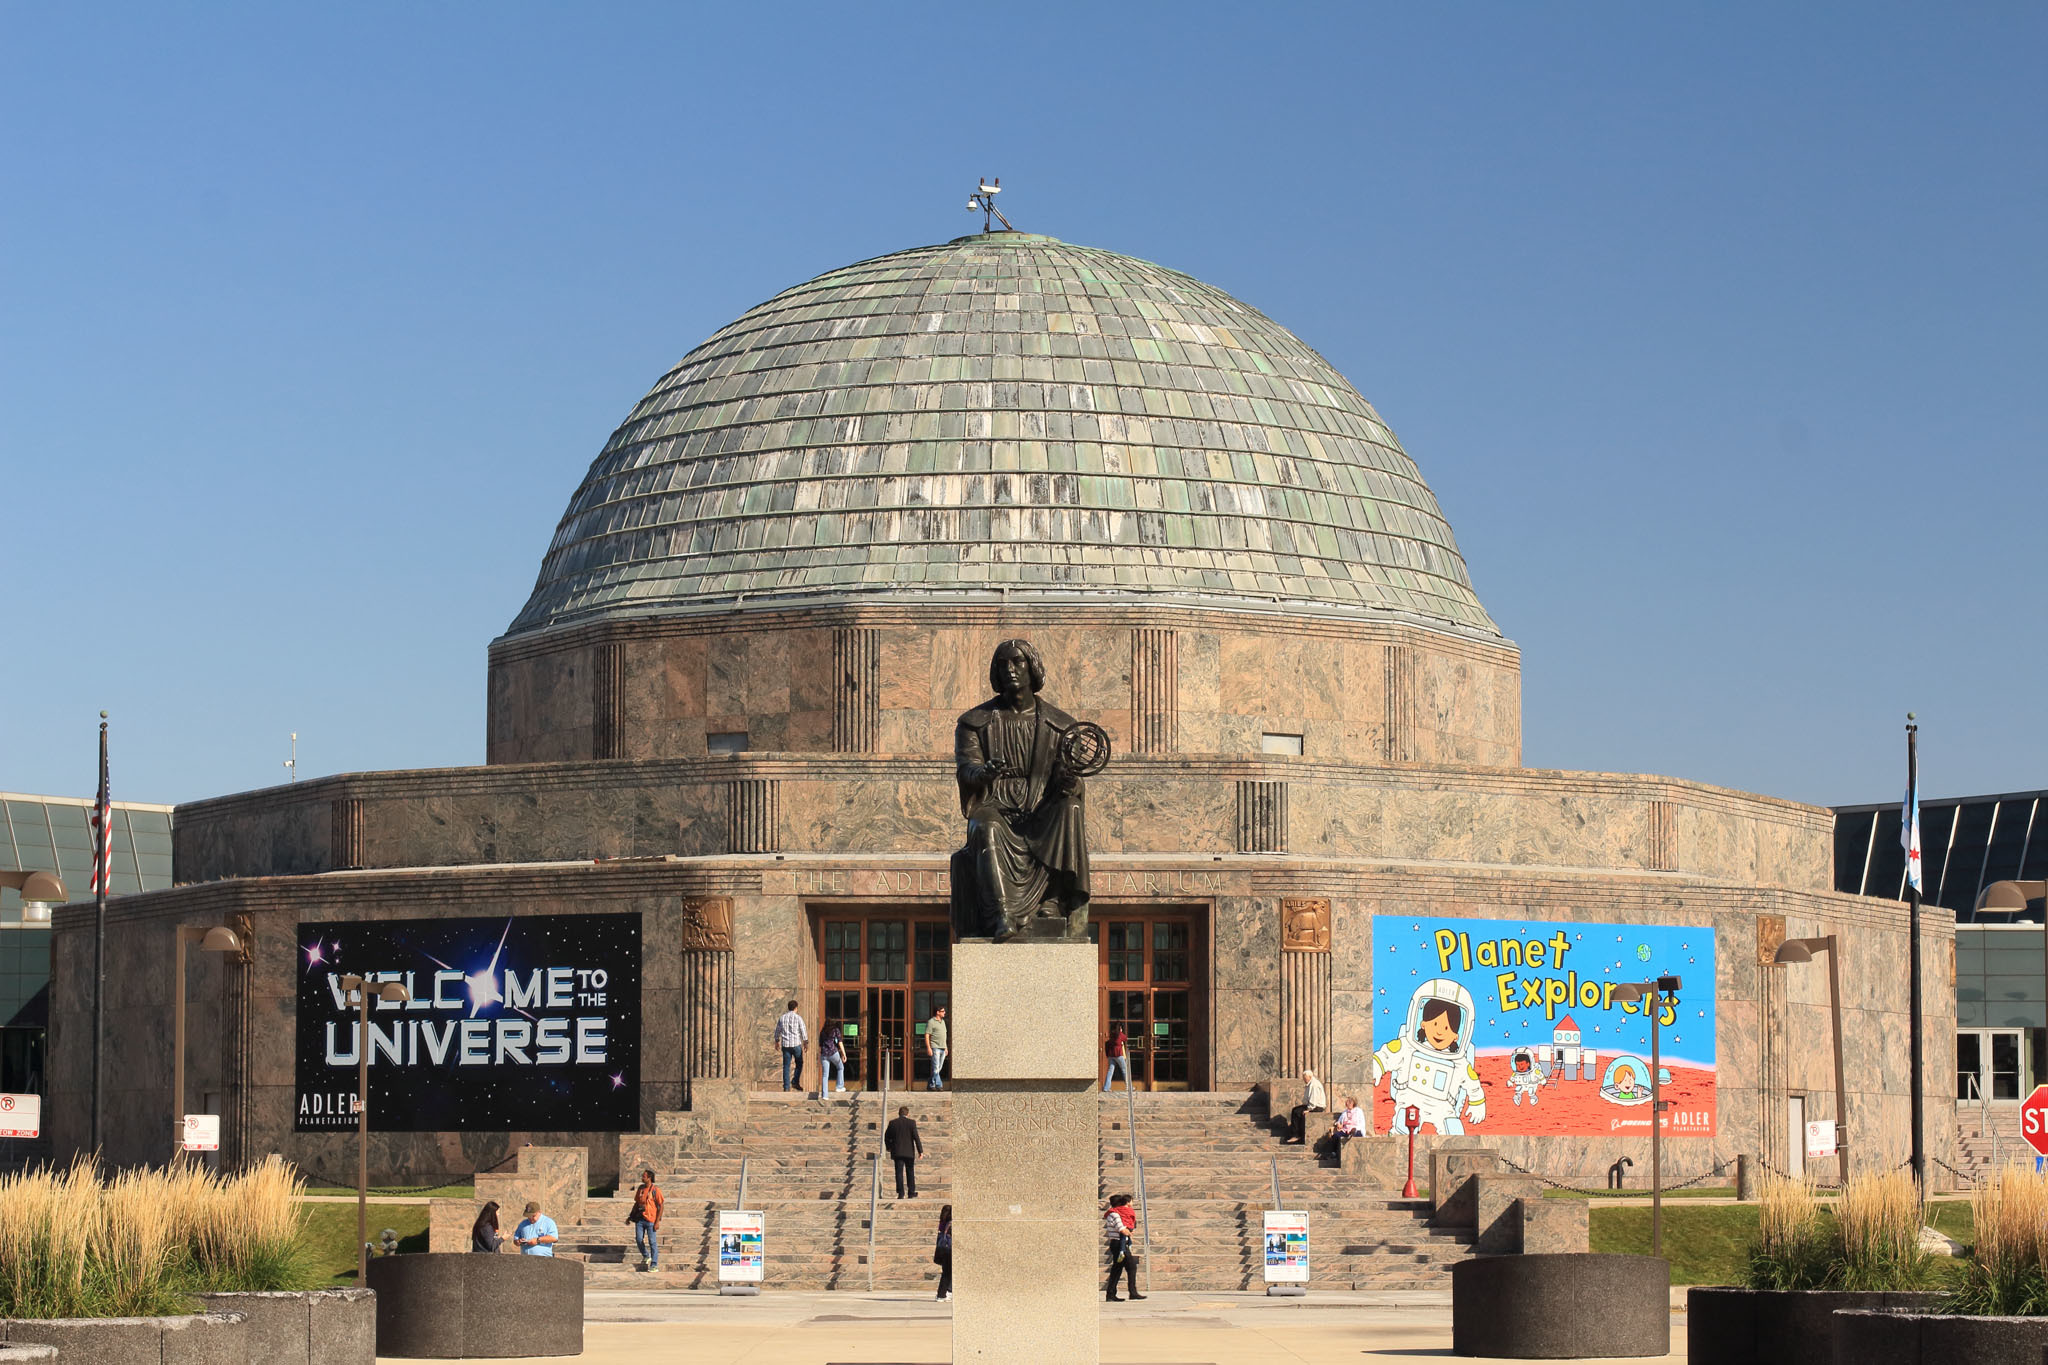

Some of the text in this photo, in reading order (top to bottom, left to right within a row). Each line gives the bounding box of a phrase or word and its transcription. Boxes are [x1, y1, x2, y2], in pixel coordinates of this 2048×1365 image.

[788, 871, 845, 892] THE
[1434, 929, 1571, 972] Planet
[577, 969, 608, 988] TO
[578, 993, 607, 1007] THE
[325, 1016, 608, 1067] UNIVERSE
[300, 1093, 358, 1115] ADLER
[974, 1096, 1077, 1113] NICOLAUS
[300, 1117, 359, 1125] PLANETARIUM
[962, 1116, 1087, 1132] COPERNICUS
[1673, 1112, 1709, 1125] ADLER
